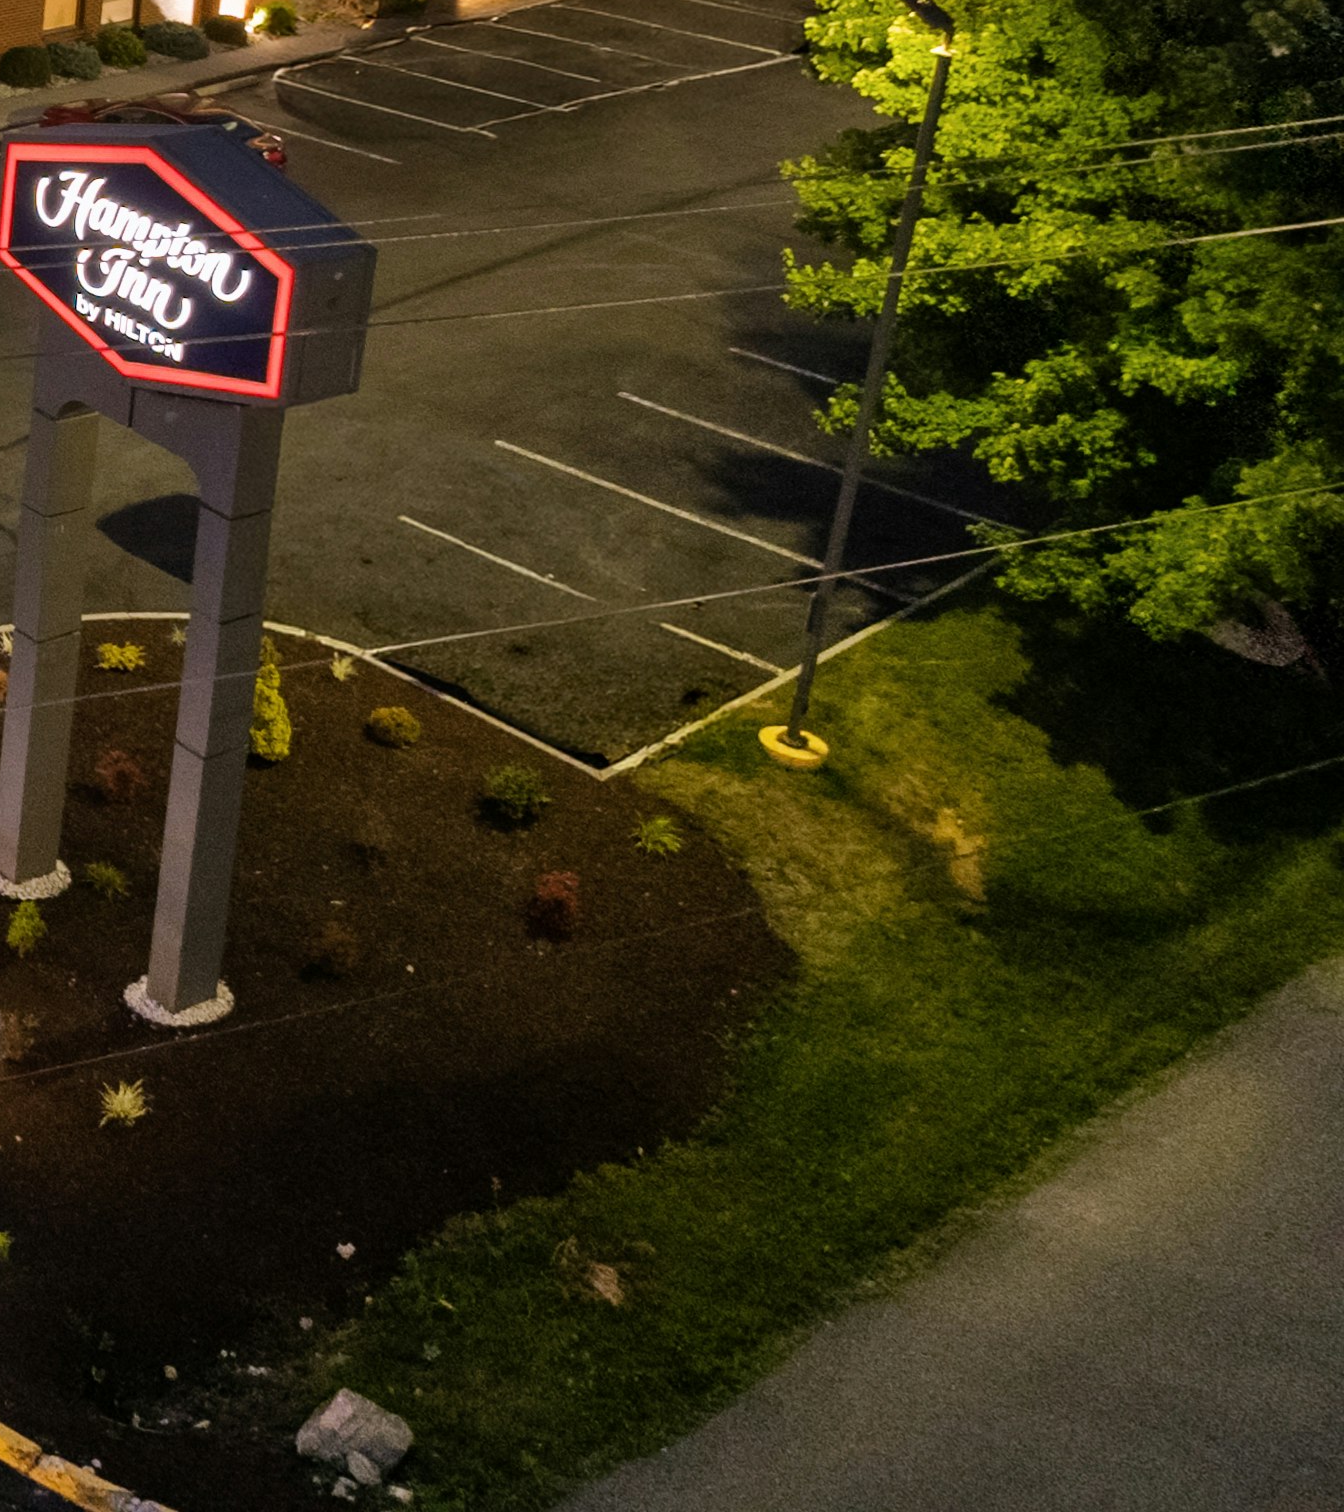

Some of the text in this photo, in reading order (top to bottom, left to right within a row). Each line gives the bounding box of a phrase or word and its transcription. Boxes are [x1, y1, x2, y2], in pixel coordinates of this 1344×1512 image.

[34, 170, 252, 302] Hampton
[75, 293, 184, 362] by HILTON
[76, 248, 191, 329] Inn
